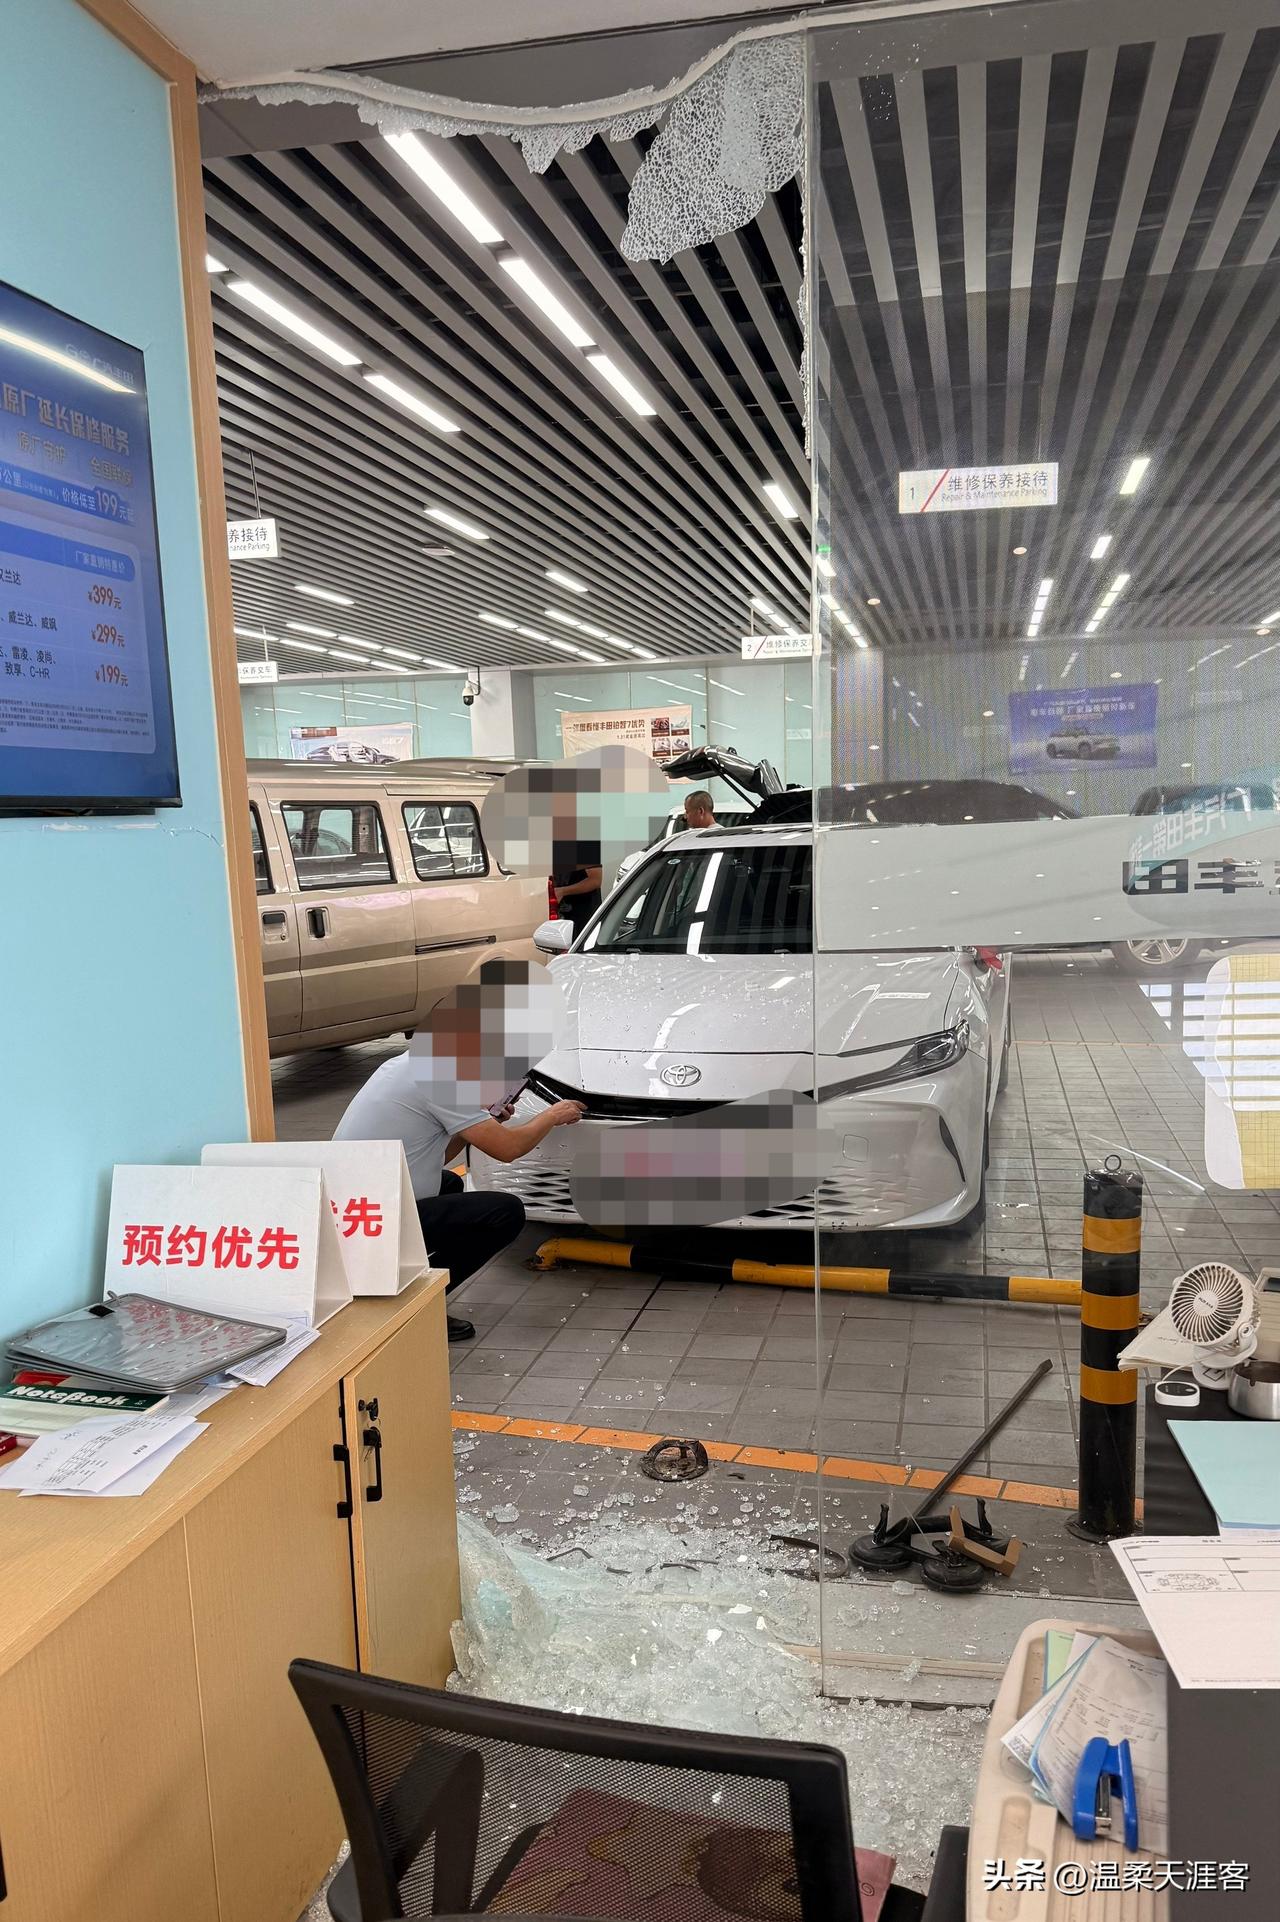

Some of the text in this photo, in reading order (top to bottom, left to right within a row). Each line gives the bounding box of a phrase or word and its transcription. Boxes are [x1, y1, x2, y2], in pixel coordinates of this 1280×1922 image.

[948, 471, 1049, 492] 维修保养接待
[1021, 487, 1048, 497] Parking
[228, 526, 268, 543] 养接待
[247, 542, 270, 552] Parking
[121, 1224, 301, 1270] 预约优先
[7, 1385, 129, 1406] NoteBook
